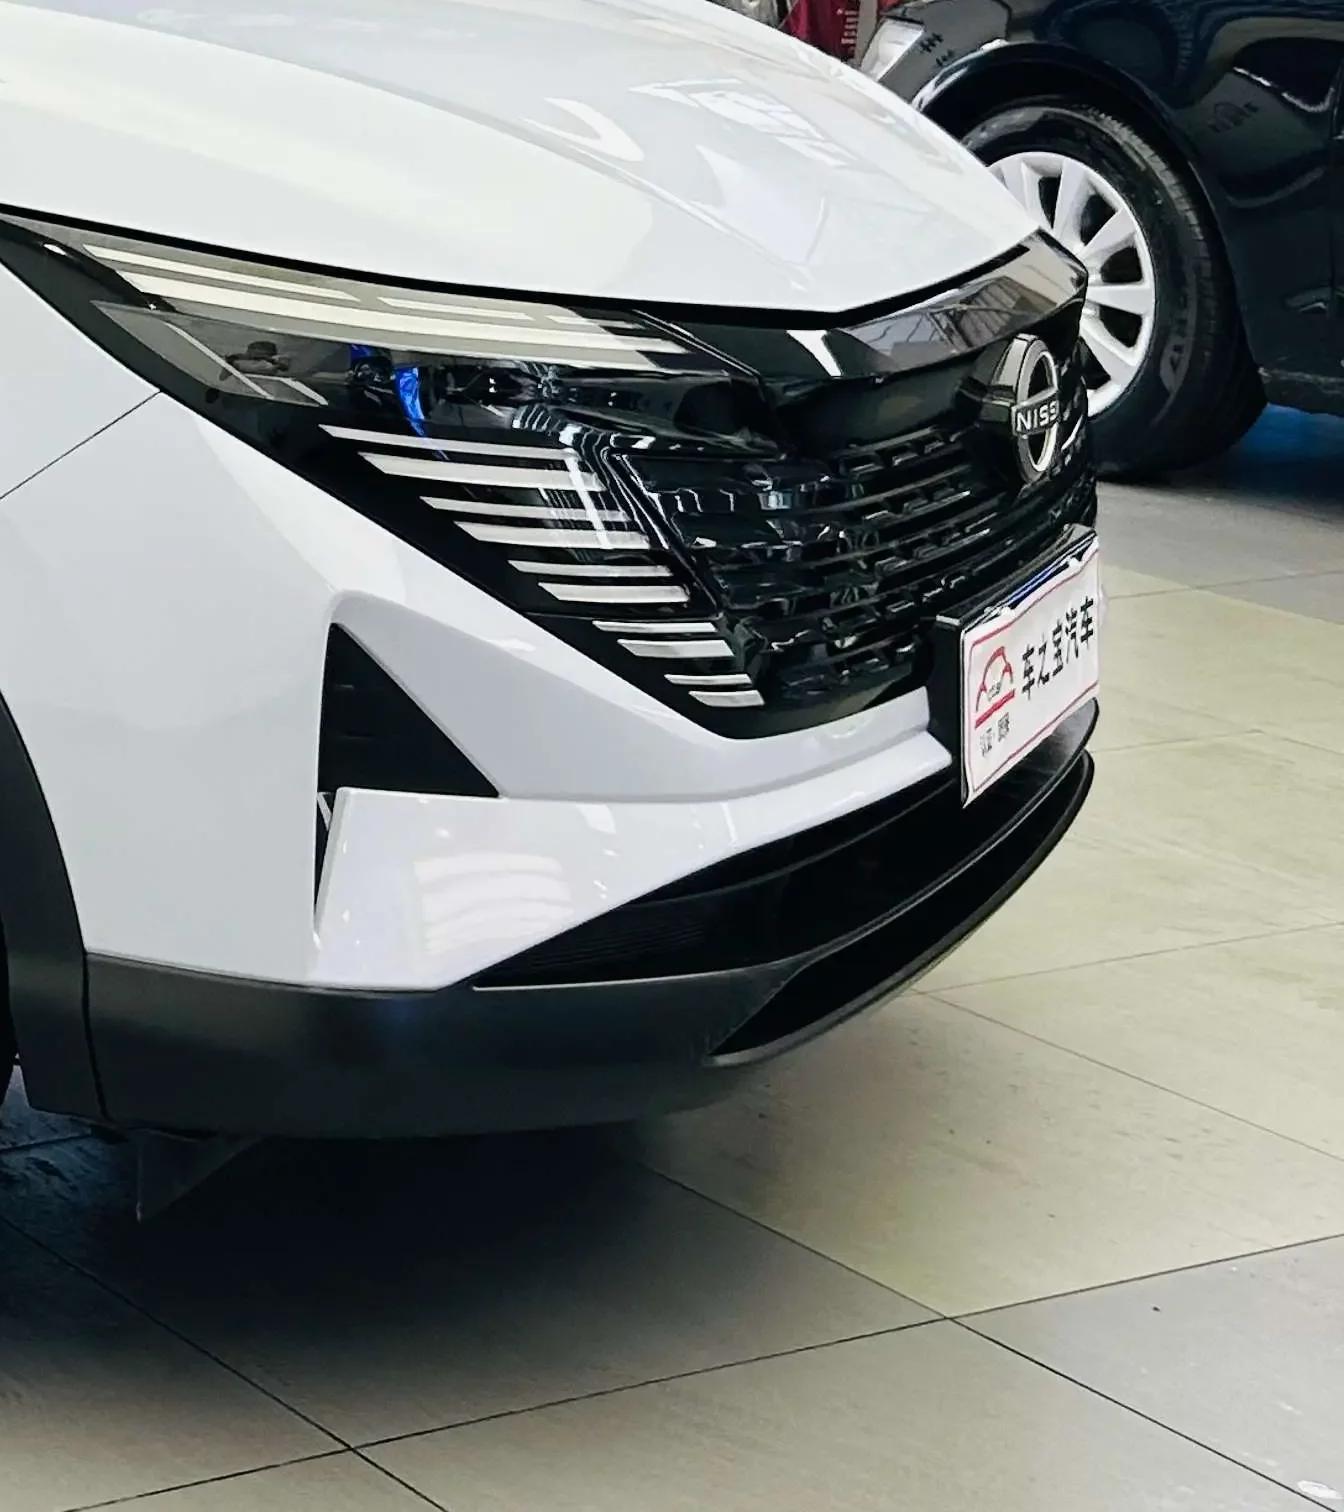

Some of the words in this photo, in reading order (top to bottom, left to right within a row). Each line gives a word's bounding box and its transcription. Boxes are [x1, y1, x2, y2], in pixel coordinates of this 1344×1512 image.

[1020, 595, 1095, 701] 车之宝汽车
